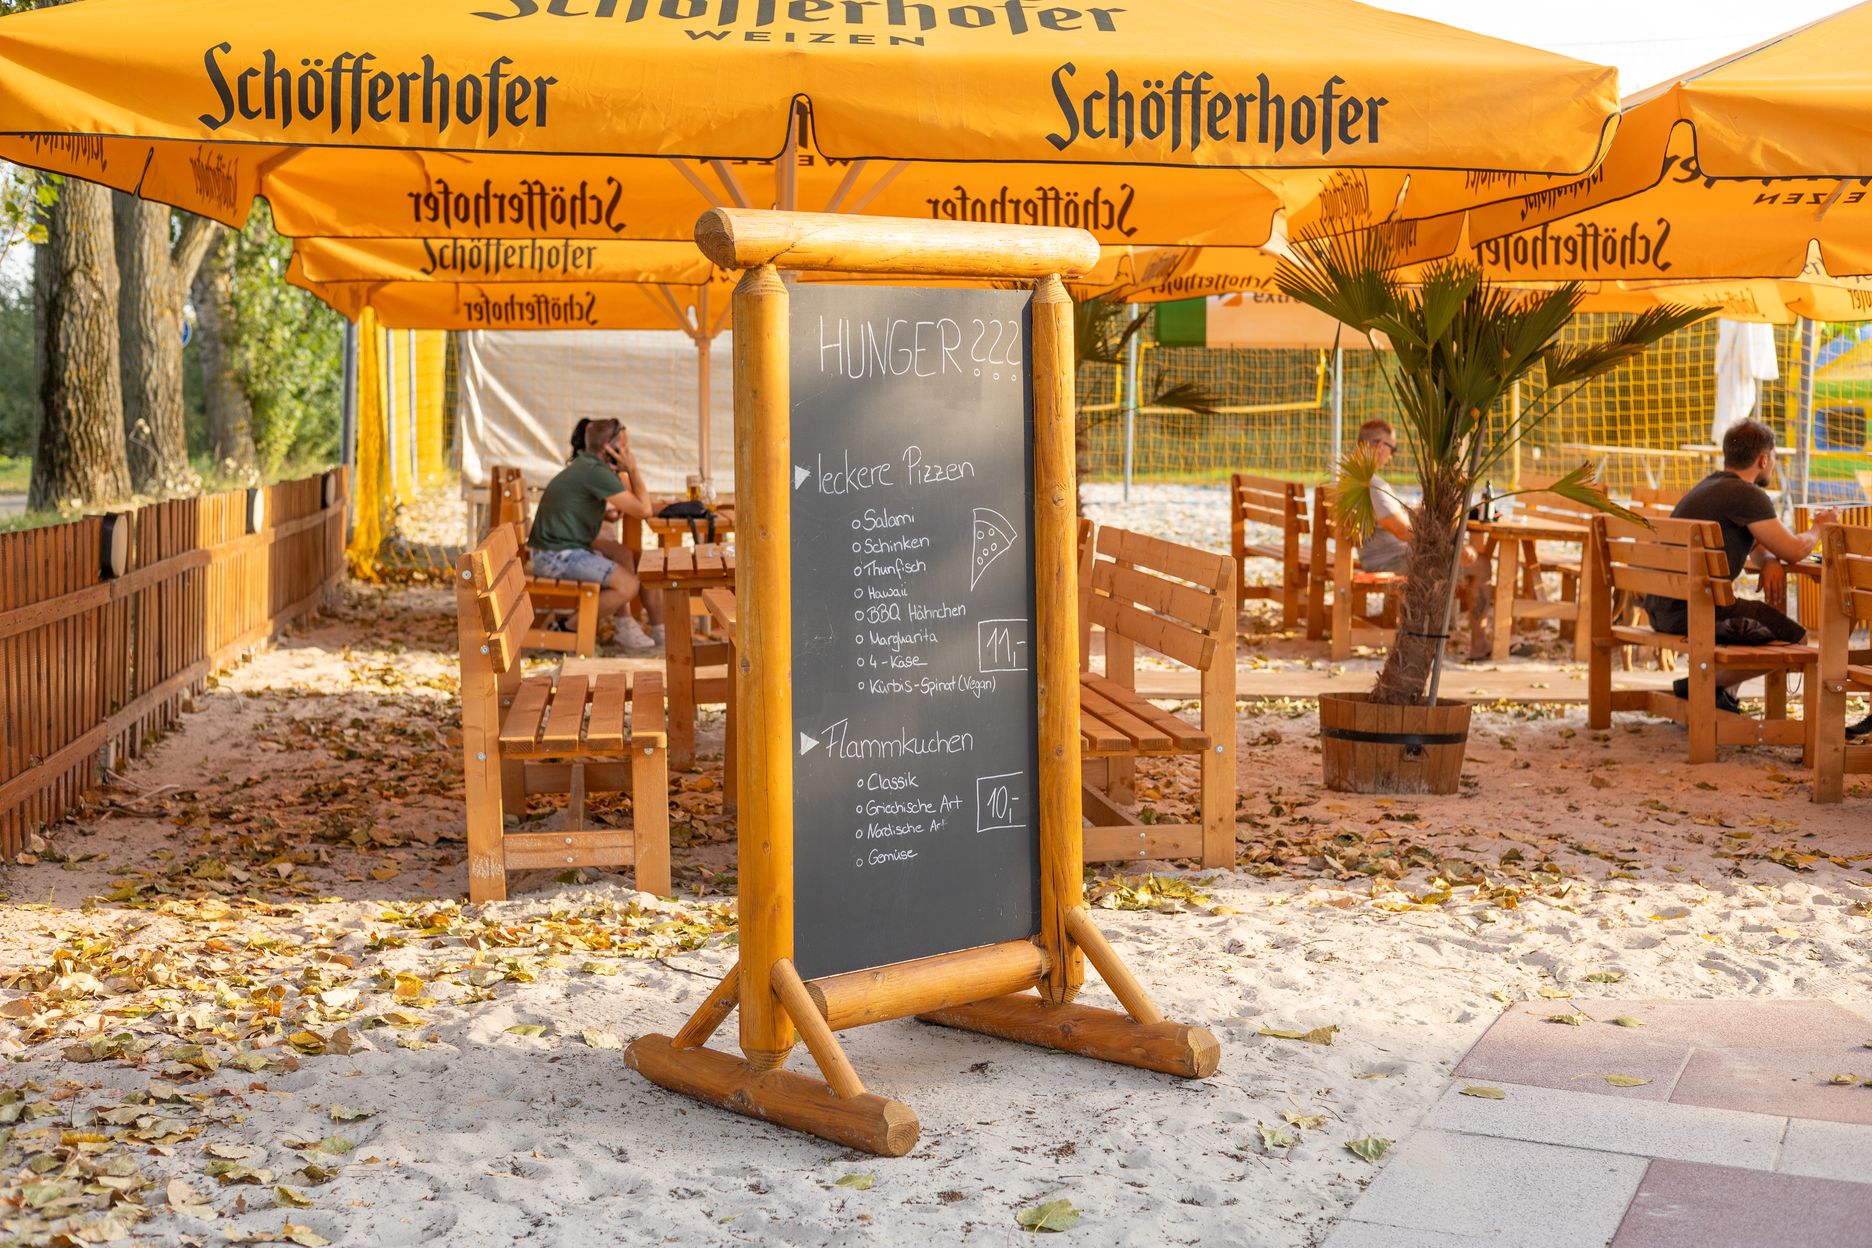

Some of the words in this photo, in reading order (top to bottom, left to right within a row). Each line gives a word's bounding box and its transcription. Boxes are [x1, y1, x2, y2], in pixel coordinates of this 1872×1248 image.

[683, 29, 925, 46] WEIZEN
[198, 41, 558, 138] Schöfferhofer
[1045, 61, 1390, 156] Schöfferhofer
[420, 239, 597, 275] Schöfferhofer
[819, 315, 962, 379] HUNGER
[970, 318, 1021, 382] ???
[818, 449, 894, 495] leckere
[902, 445, 975, 485] Pizzen
[862, 506, 915, 531] Salami
[863, 535, 930, 554] Schinken
[863, 558, 927, 579] Thunfisch
[867, 581, 908, 600] Hawaii
[866, 602, 901, 624] BBQ
[908, 602, 967, 622] Hähnchen
[958, 674, 996, 699] (Vegan)
[821, 718, 974, 759] Flammkuchen
[867, 771, 919, 791] Classik
[865, 798, 937, 816] Griechische
[939, 794, 964, 814] Art
[867, 821, 925, 840] Nordische
[929, 818, 949, 833] Art
[868, 849, 919, 866] Gemüse
